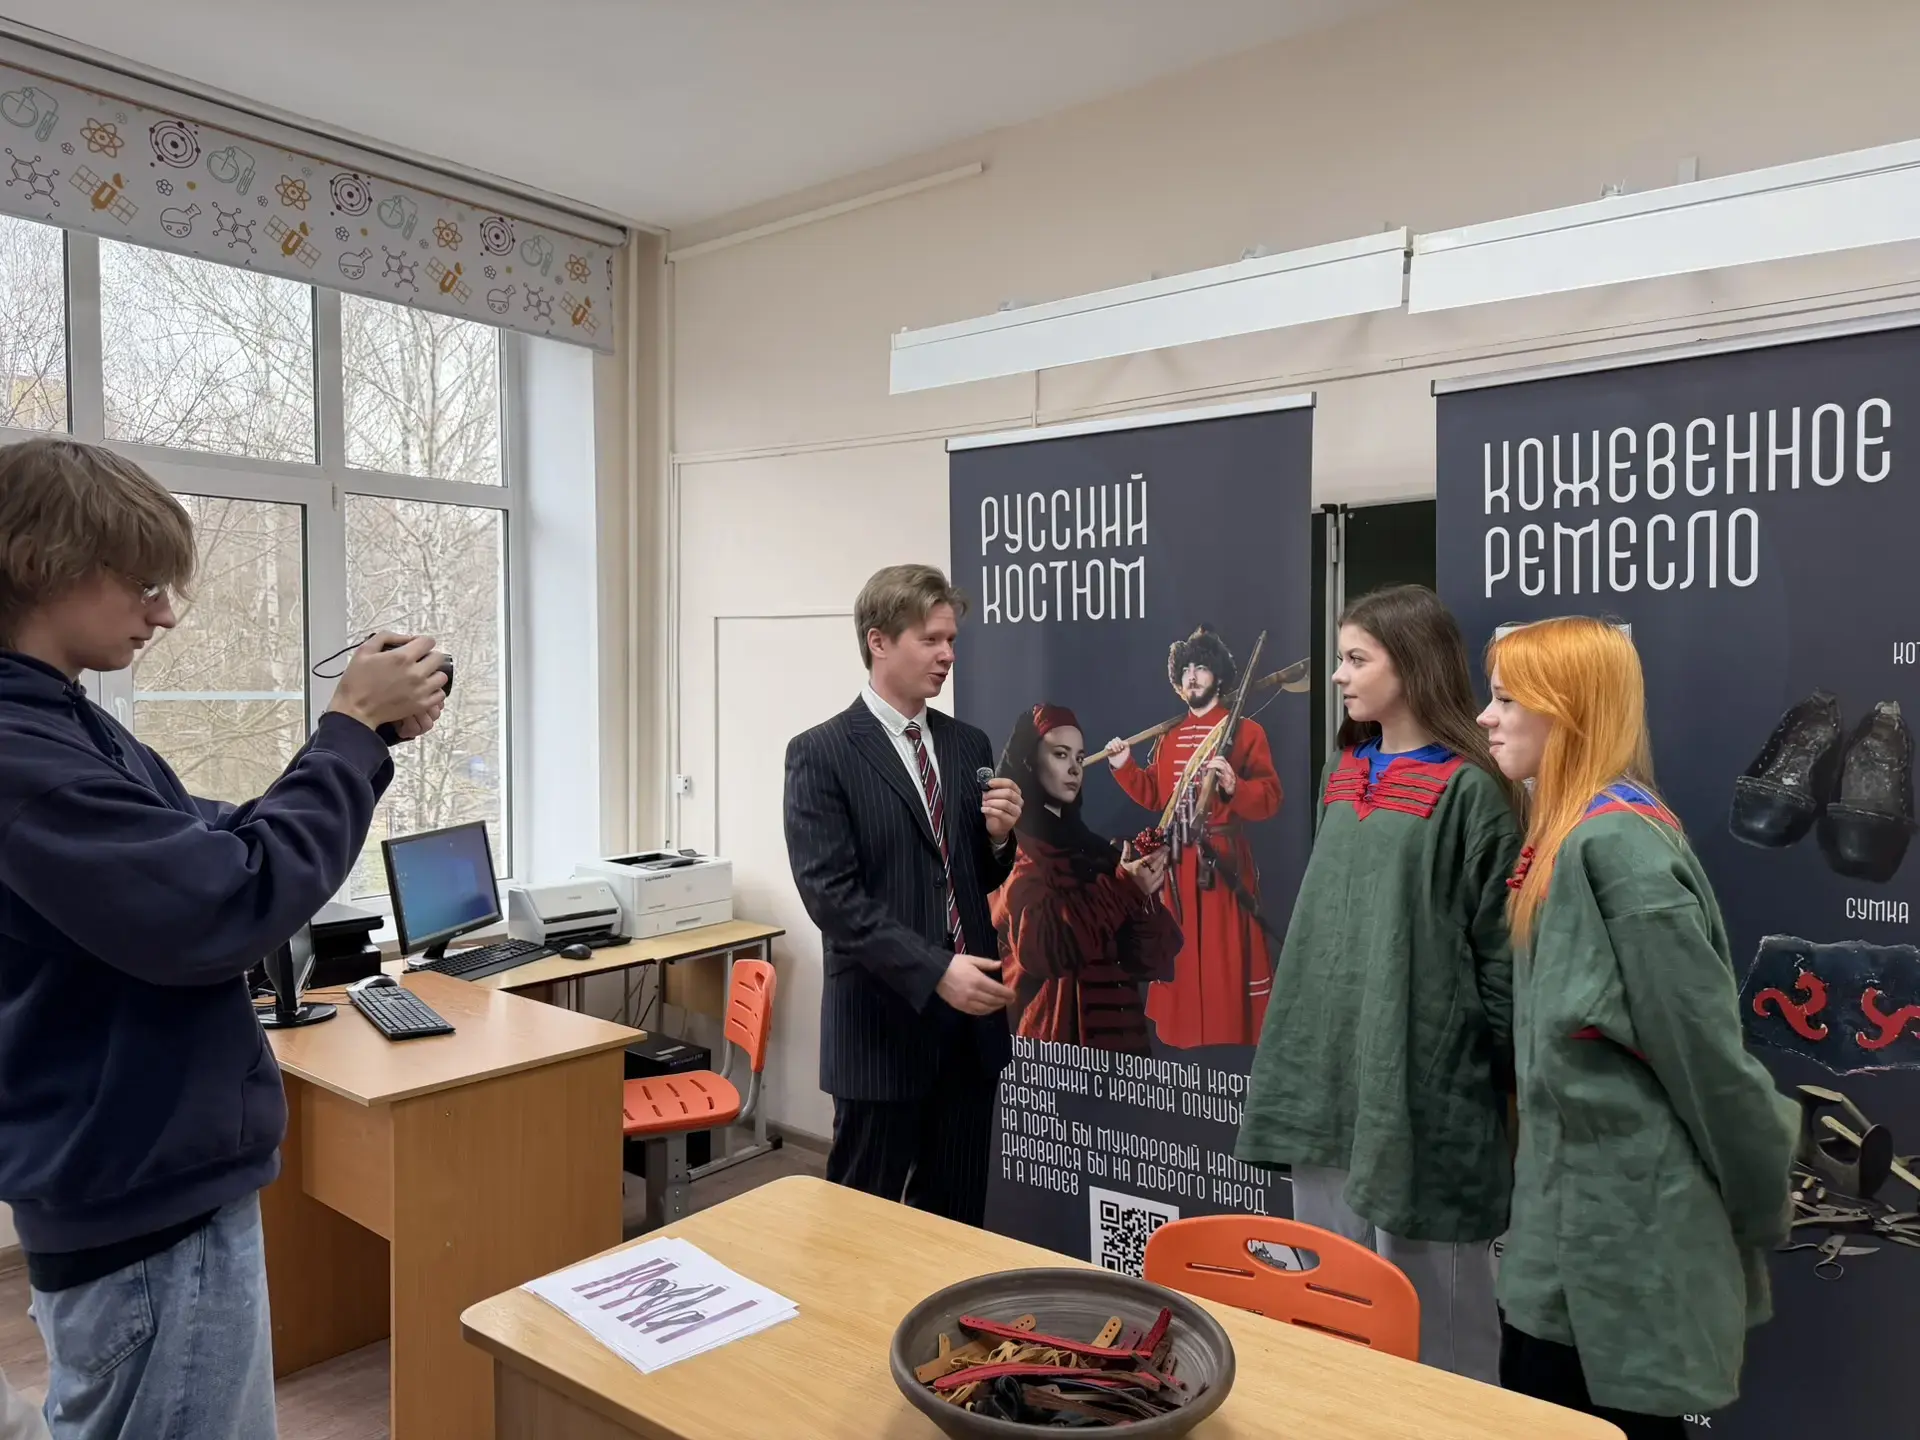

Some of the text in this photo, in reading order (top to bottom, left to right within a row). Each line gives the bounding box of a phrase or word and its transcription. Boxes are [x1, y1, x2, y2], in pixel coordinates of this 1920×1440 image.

[1485, 398, 1891, 514] КОЖЕВЕННОЕ
[981, 473, 1147, 556] РУССКИЙ
[1485, 508, 1759, 598] РЕМЕСЛО
[983, 556, 1145, 624] КОСТЮМ
[1846, 898, 1909, 924] СУМКА
[1010, 1034, 1251, 1098] БЫ МОЛОДЦУ УЗОРЧАТЫЙ КАФТ
[1022, 1061, 1088, 1095] САПОЖКИ
[1094, 1074, 1103, 1098] С
[1109, 1076, 1175, 1112] КРАСНОЙ
[1000, 1082, 1059, 1117] САФЬЯН,
[1001, 1106, 1017, 1131] НА
[1023, 1111, 1067, 1142] ПОРТЫ
[1072, 1121, 1092, 1148] БЫ
[1097, 1126, 1200, 1171] МУХОЯРОВЫЙ
[1001, 1132, 1269, 1216] ДИВОВАЛСЯ БЫ НА ДОБРОГО НАРОД.
[1003, 1156, 1079, 1195] Н А КЛЮЕВ
